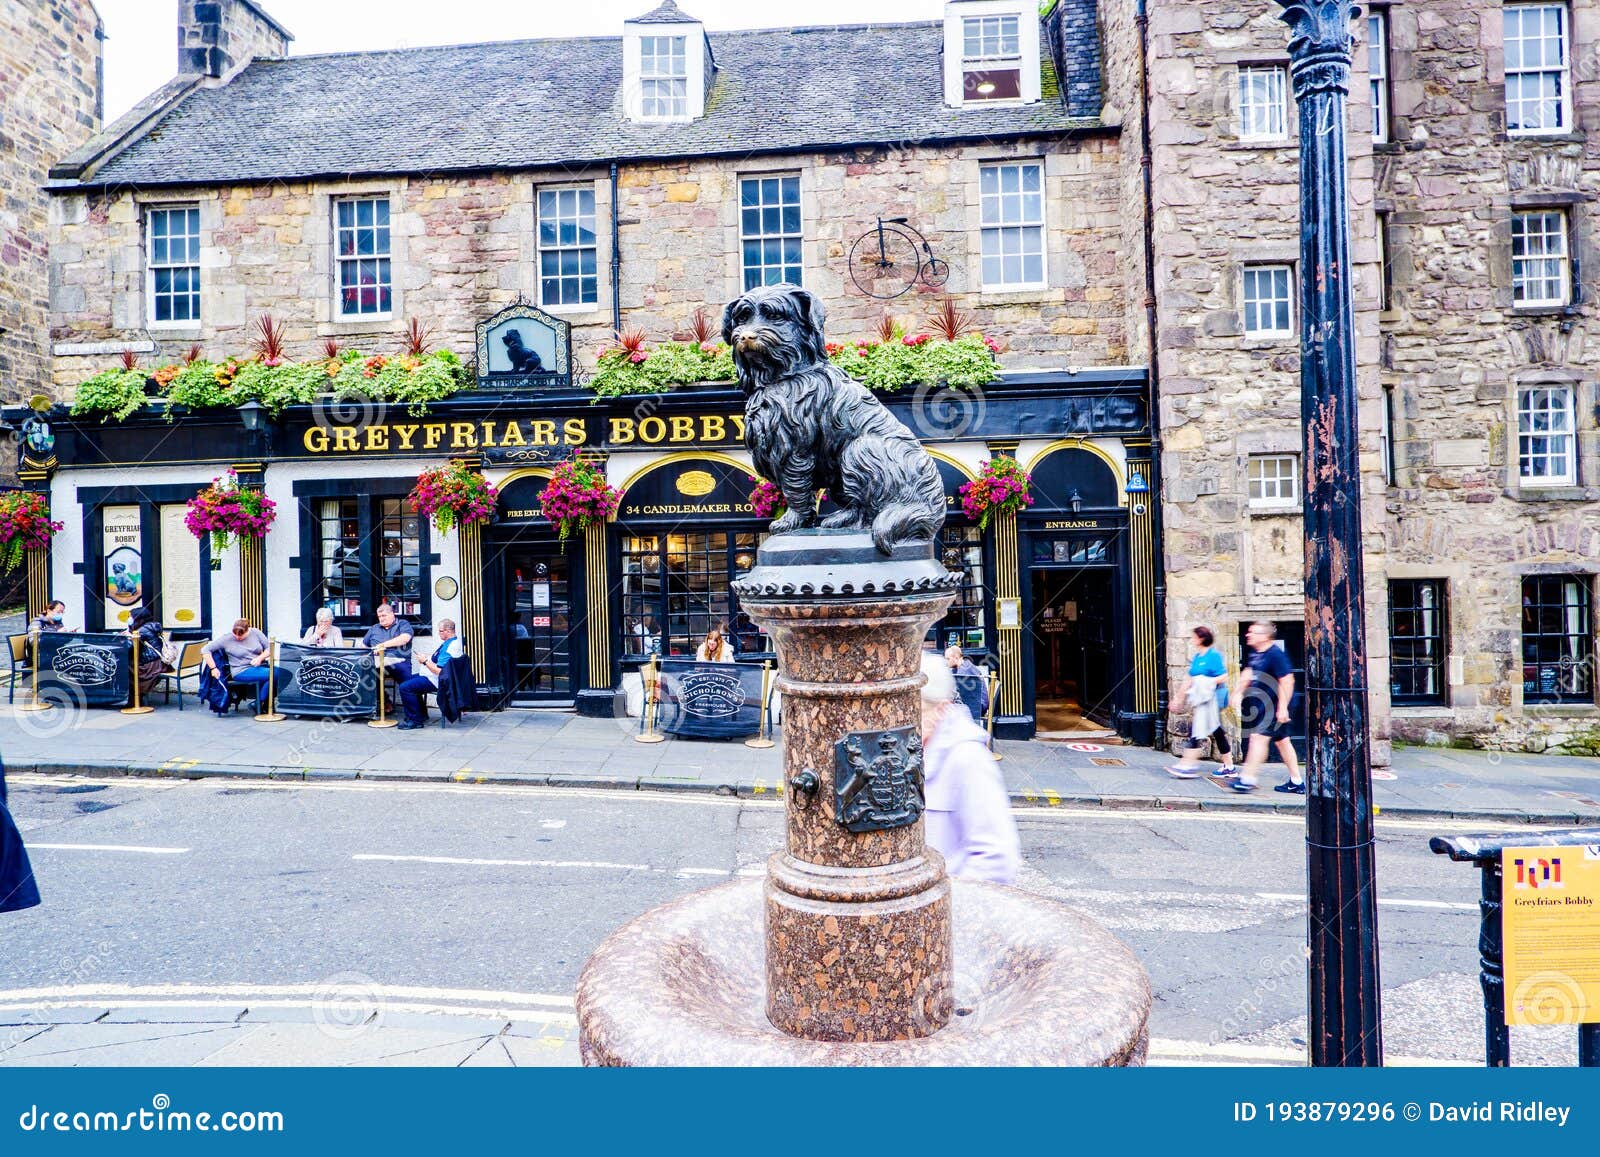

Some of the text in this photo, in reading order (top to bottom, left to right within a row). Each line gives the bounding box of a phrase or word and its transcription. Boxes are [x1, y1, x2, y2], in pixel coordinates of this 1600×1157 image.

[303, 415, 746, 452] GREYFRIARS BOBBY
[626, 505, 640, 514] 34
[643, 504, 731, 514] CANDLEMAKER
[1045, 520, 1098, 529] ENTRANCE
[114, 535, 136, 544] BOBBY
[302, 671, 354, 684] NICHOLSON'S
[684, 688, 738, 702] NICHOLSON'S
[1514, 858, 1564, 889] 101
[1514, 896, 1594, 908] Greyfriars Bobby
